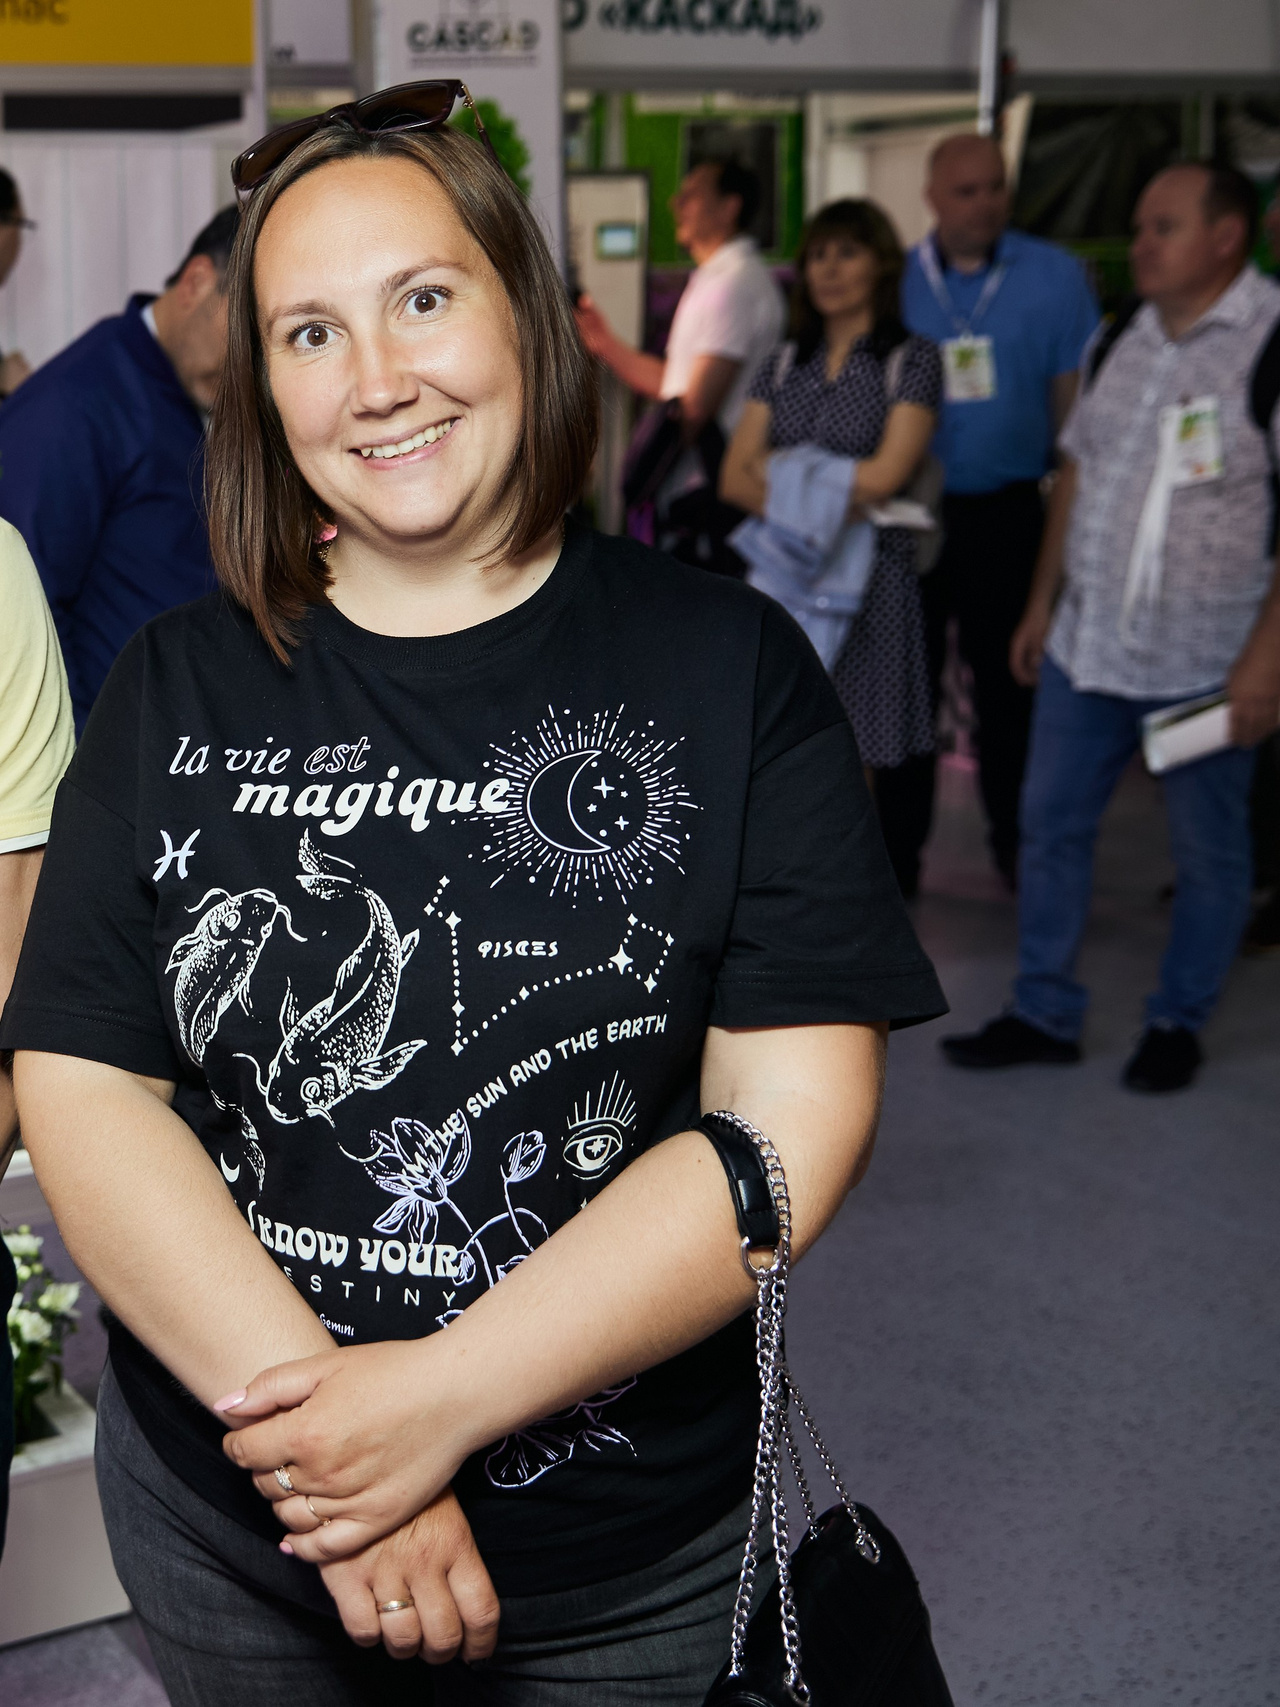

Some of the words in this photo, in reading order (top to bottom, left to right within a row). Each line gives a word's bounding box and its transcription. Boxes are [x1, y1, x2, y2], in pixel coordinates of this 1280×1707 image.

[169, 736, 210, 776] la
[224, 737, 291, 775] vie
[303, 736, 371, 775] est
[232, 765, 511, 837] magique
[424, 1112, 465, 1154] THE
[466, 1076, 508, 1118] SUN
[509, 1048, 552, 1087] AND
[555, 1028, 599, 1060] THE
[606, 1013, 667, 1043] EARTH
[257, 1213, 349, 1268] KNOW
[358, 1237, 460, 1278] YOUR
[283, 1265, 456, 1307] ESTINY
